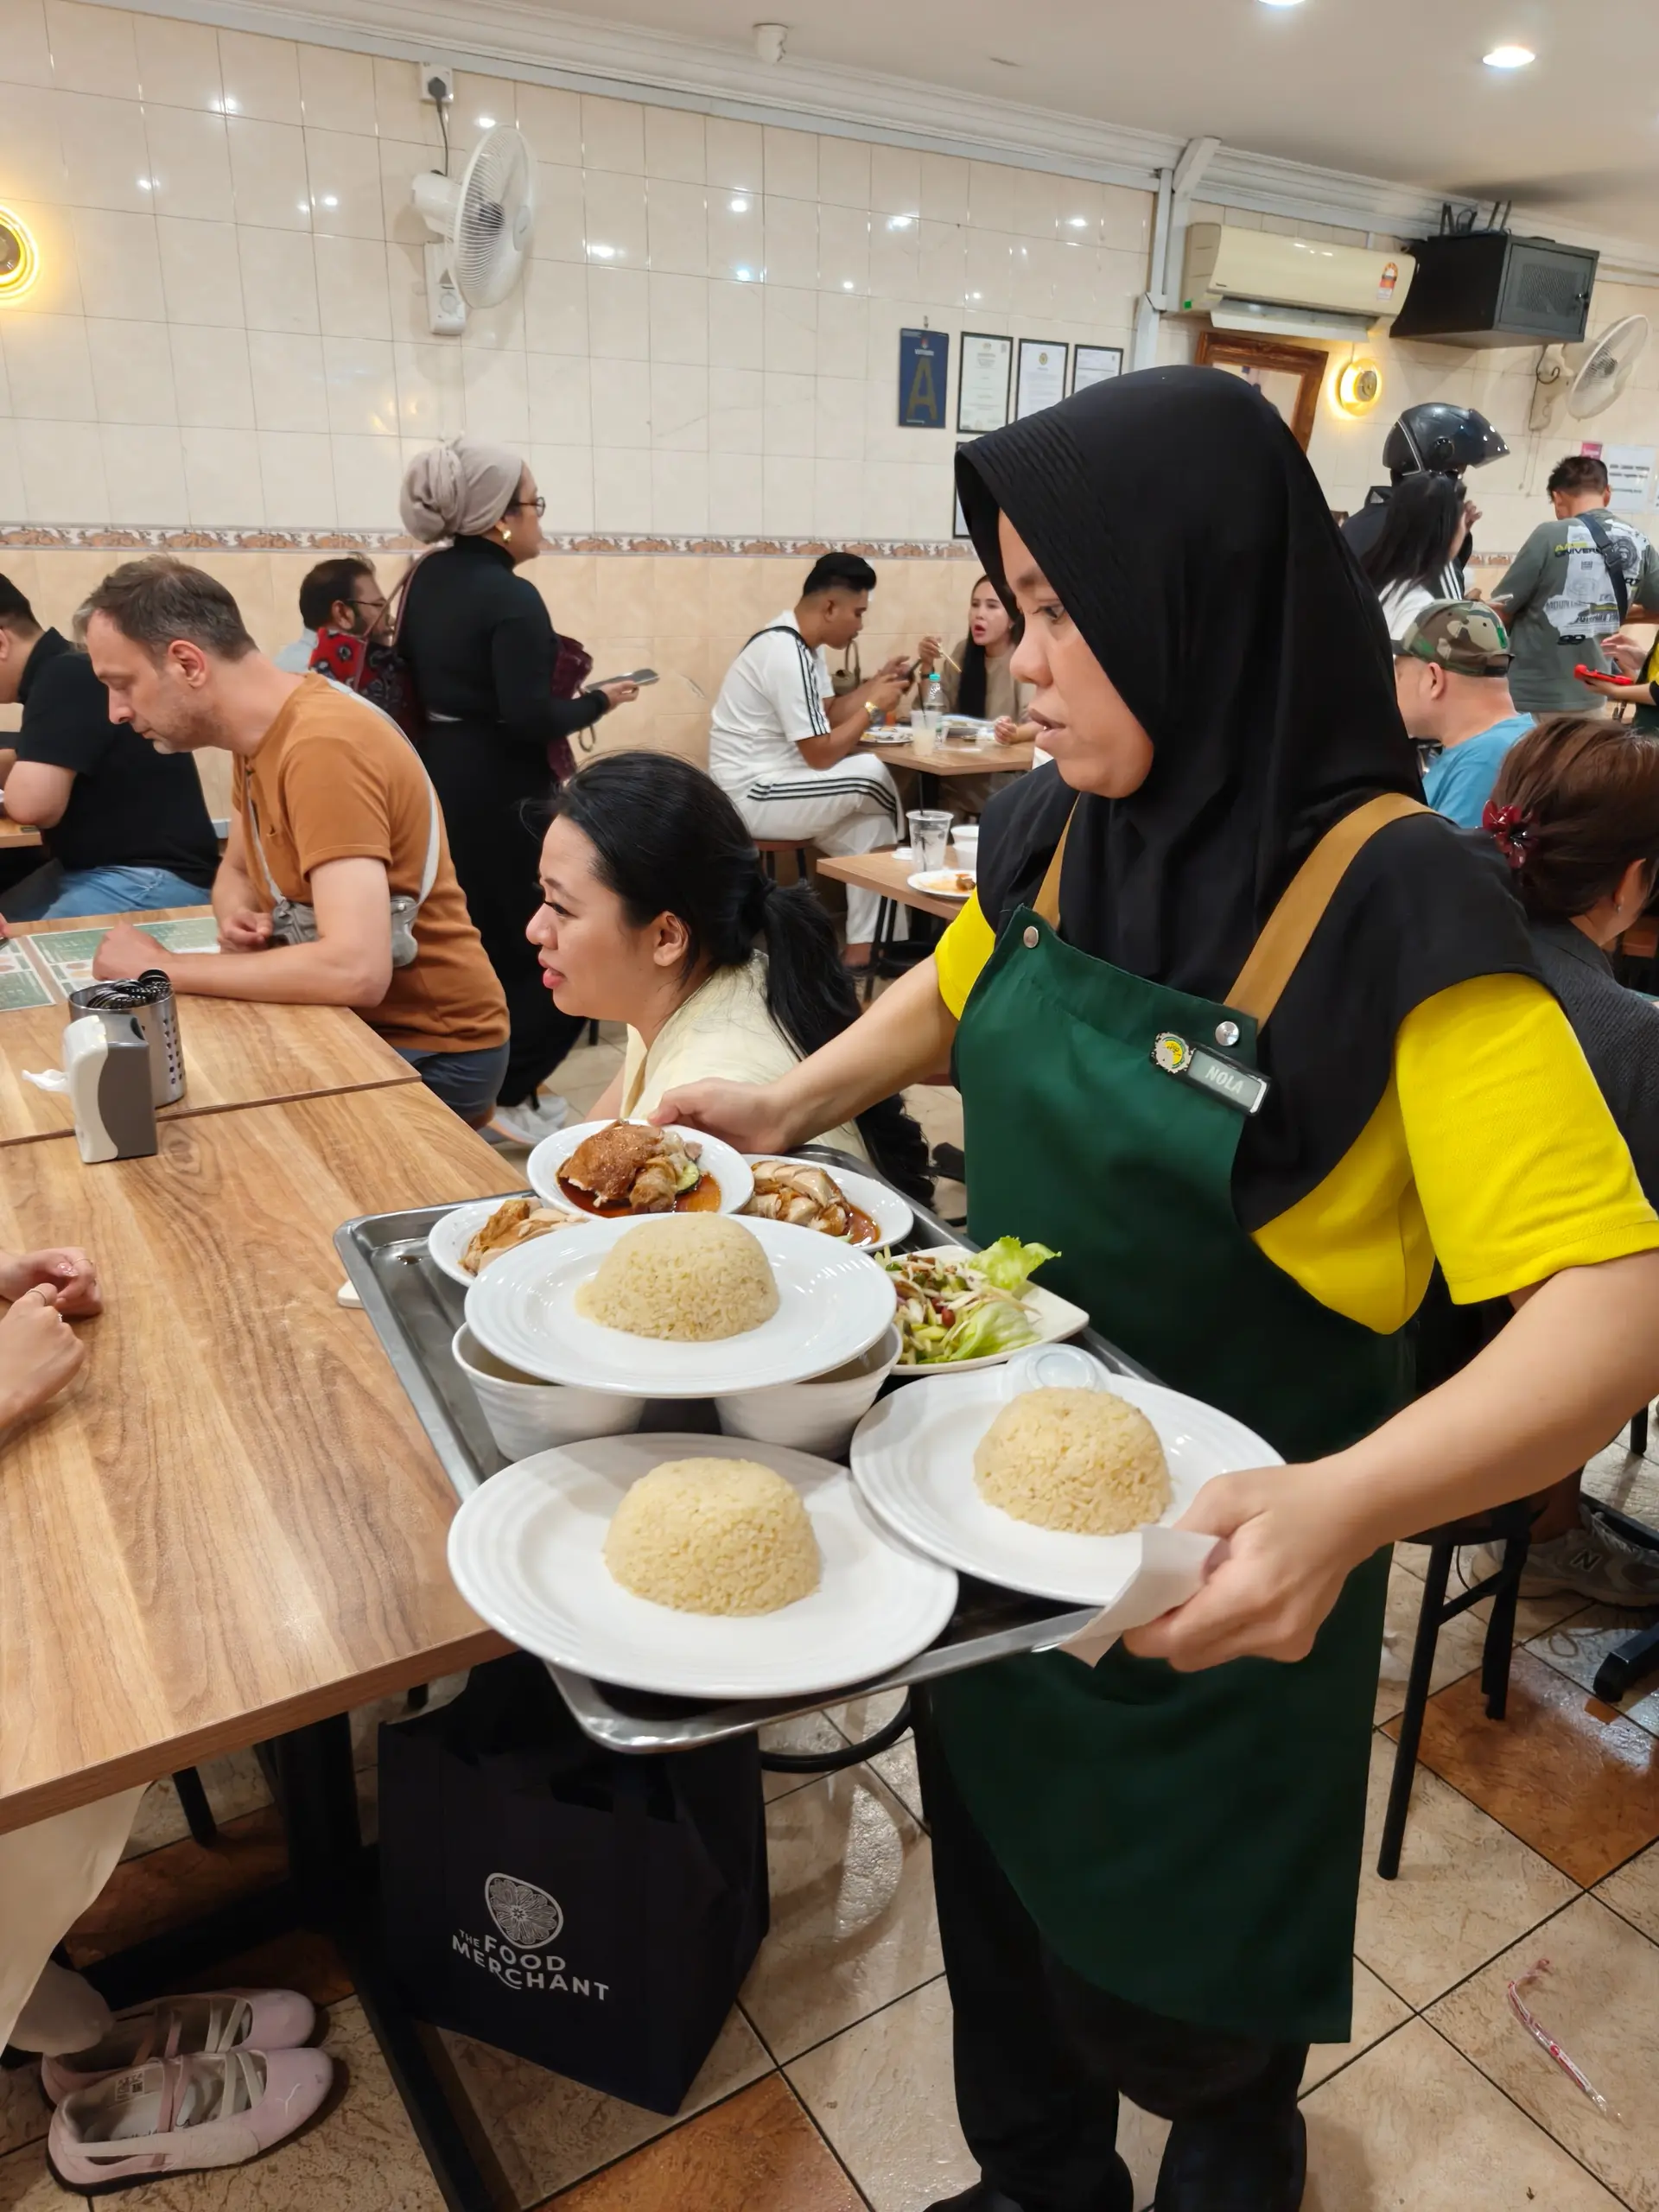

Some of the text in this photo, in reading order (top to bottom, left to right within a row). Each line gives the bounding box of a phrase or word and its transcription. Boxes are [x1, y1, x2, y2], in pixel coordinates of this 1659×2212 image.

[906, 355, 938, 421] A
[1205, 1065, 1244, 1095] NOLA
[1570, 1548, 1602, 1573] N
[452, 1934, 609, 2001] MERCHANT
[459, 1929, 566, 1971] THE FOOD
